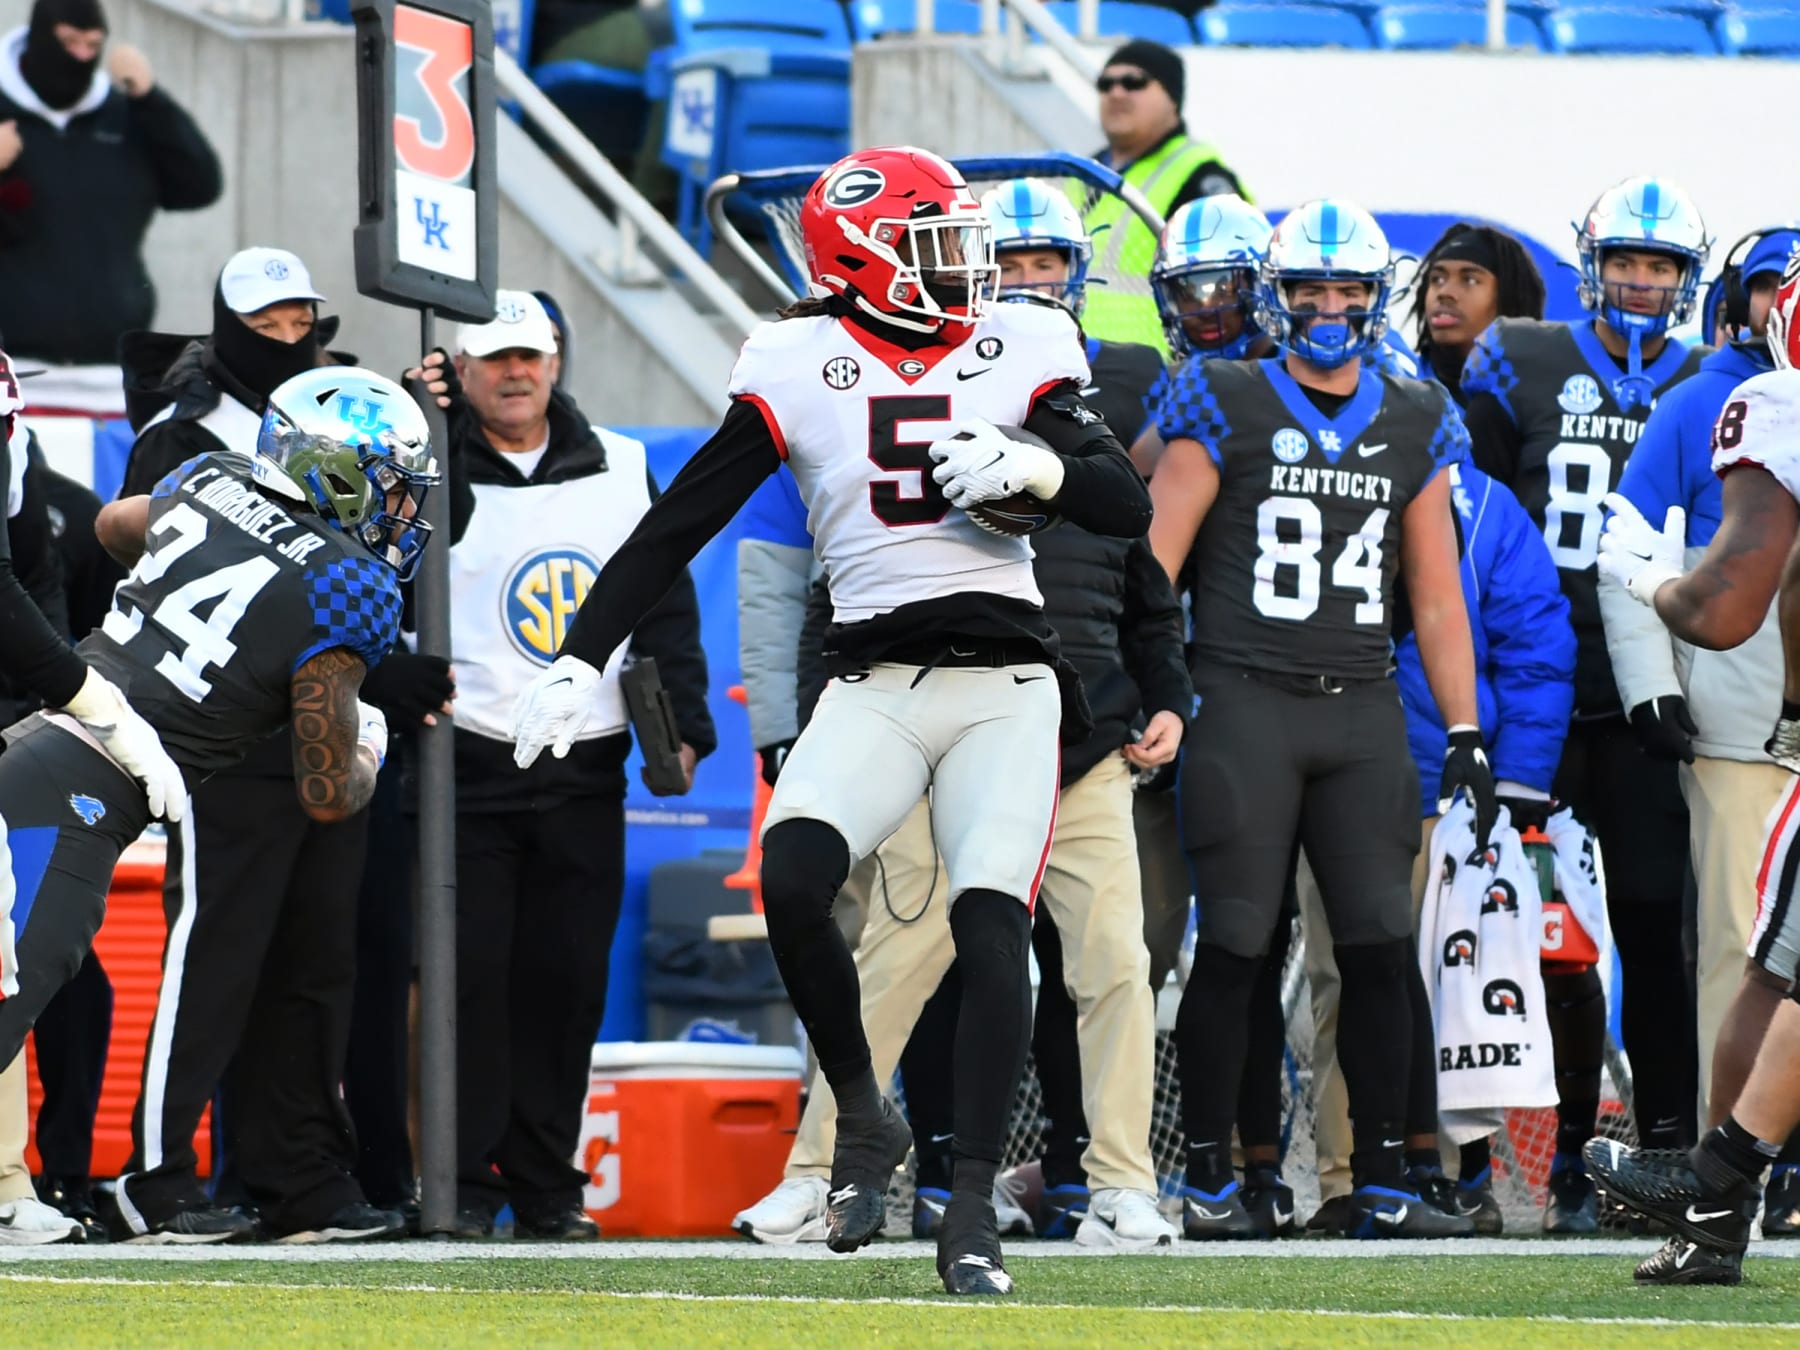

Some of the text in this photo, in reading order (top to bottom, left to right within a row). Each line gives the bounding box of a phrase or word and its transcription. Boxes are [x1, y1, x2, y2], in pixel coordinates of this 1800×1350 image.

[393, 5, 474, 181] 3
[825, 167, 886, 208] G
[414, 197, 449, 250] UK
[823, 357, 860, 390] SEC
[898, 360, 925, 375] G
[1563, 374, 1599, 404] SEC
[337, 394, 393, 456] UK
[1273, 429, 1308, 462] SEC
[1711, 400, 1749, 451] 8
[868, 395, 951, 527] 5
[1270, 465, 1392, 502] KENTUCKY
[276, 532, 326, 566] JR.
[1253, 496, 1391, 624] 84
[102, 502, 280, 703] 24
